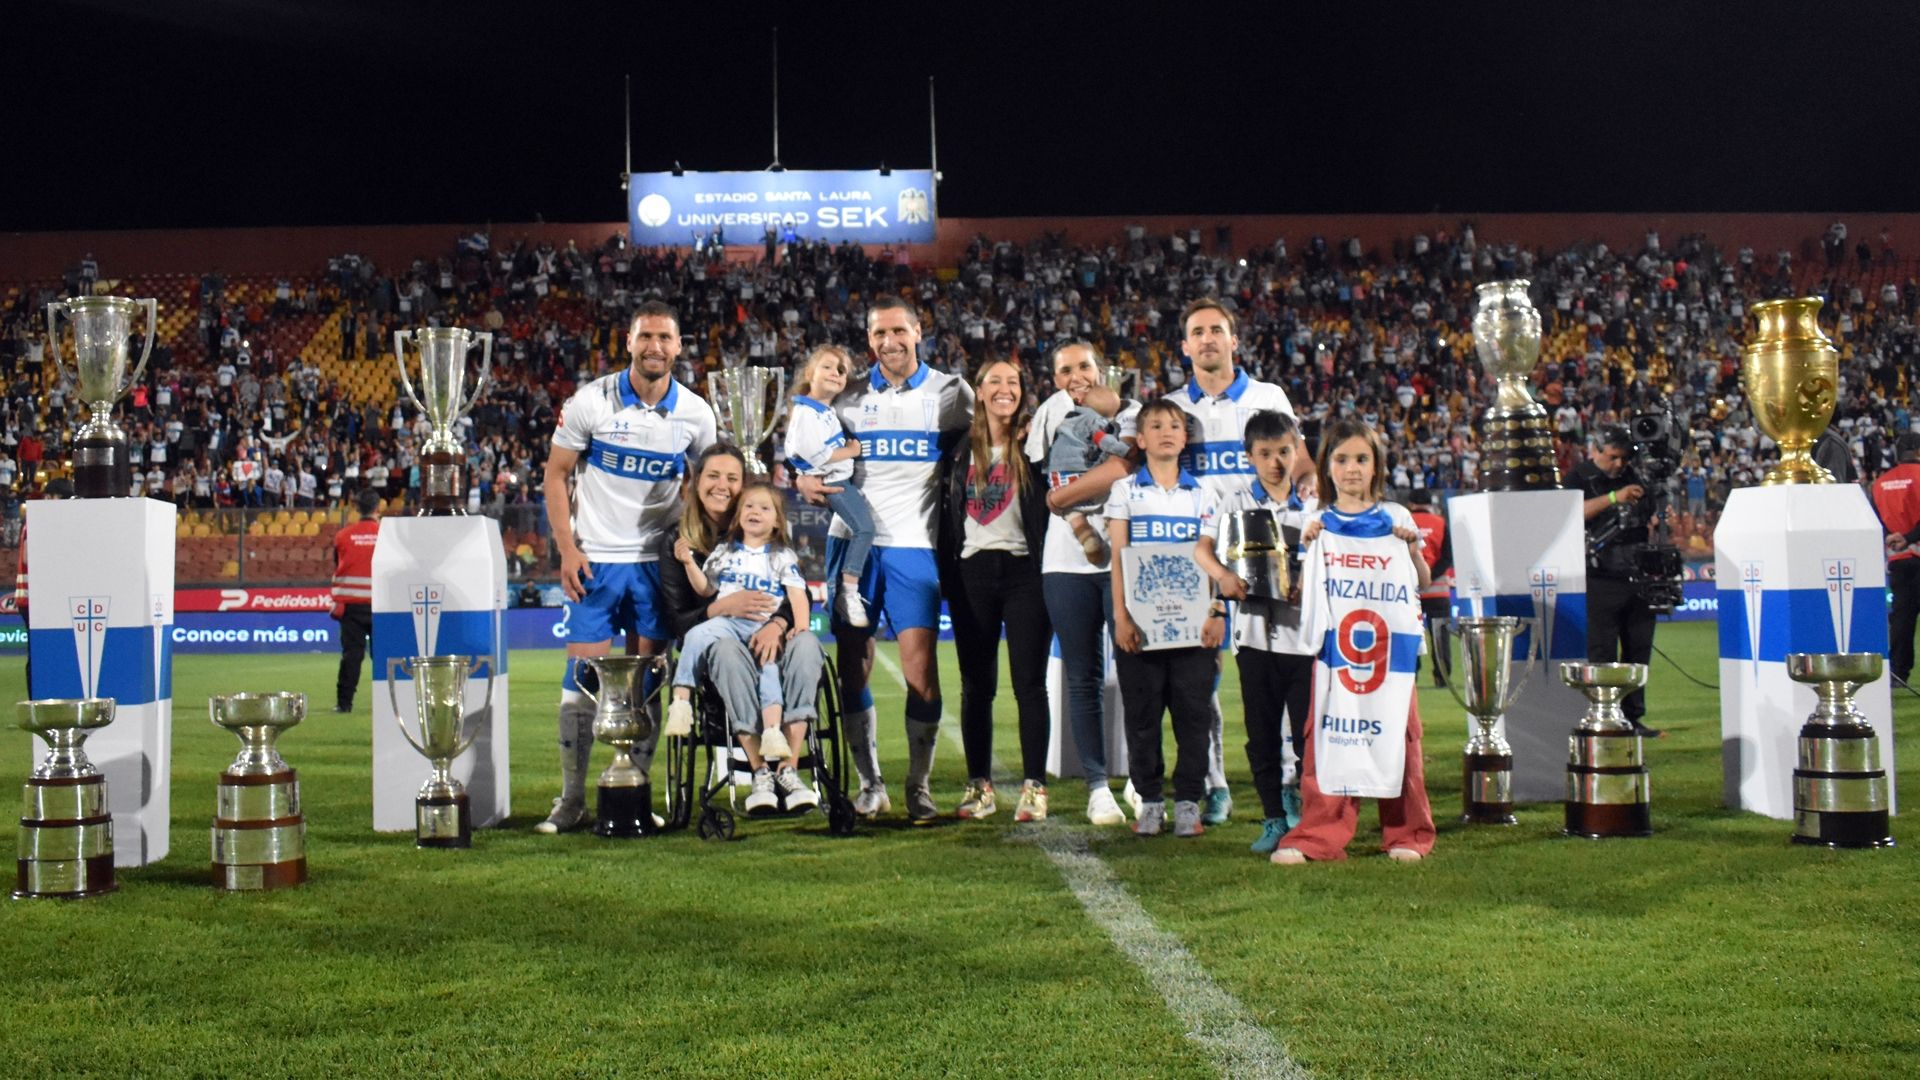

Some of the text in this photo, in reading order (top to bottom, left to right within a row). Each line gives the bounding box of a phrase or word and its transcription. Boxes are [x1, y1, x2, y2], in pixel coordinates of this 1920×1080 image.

[695, 191, 872, 204] ESTADIO SANTA LAURA
[678, 206, 888, 228] UNIVERSIDAD SEK
[876, 438, 928, 456] BICE
[623, 456, 673, 475] BICE
[1196, 450, 1250, 471] BICE
[787, 511, 829, 525] SEK
[172, 626, 329, 643] Conoce más en
[1337, 609, 1389, 695] 9
